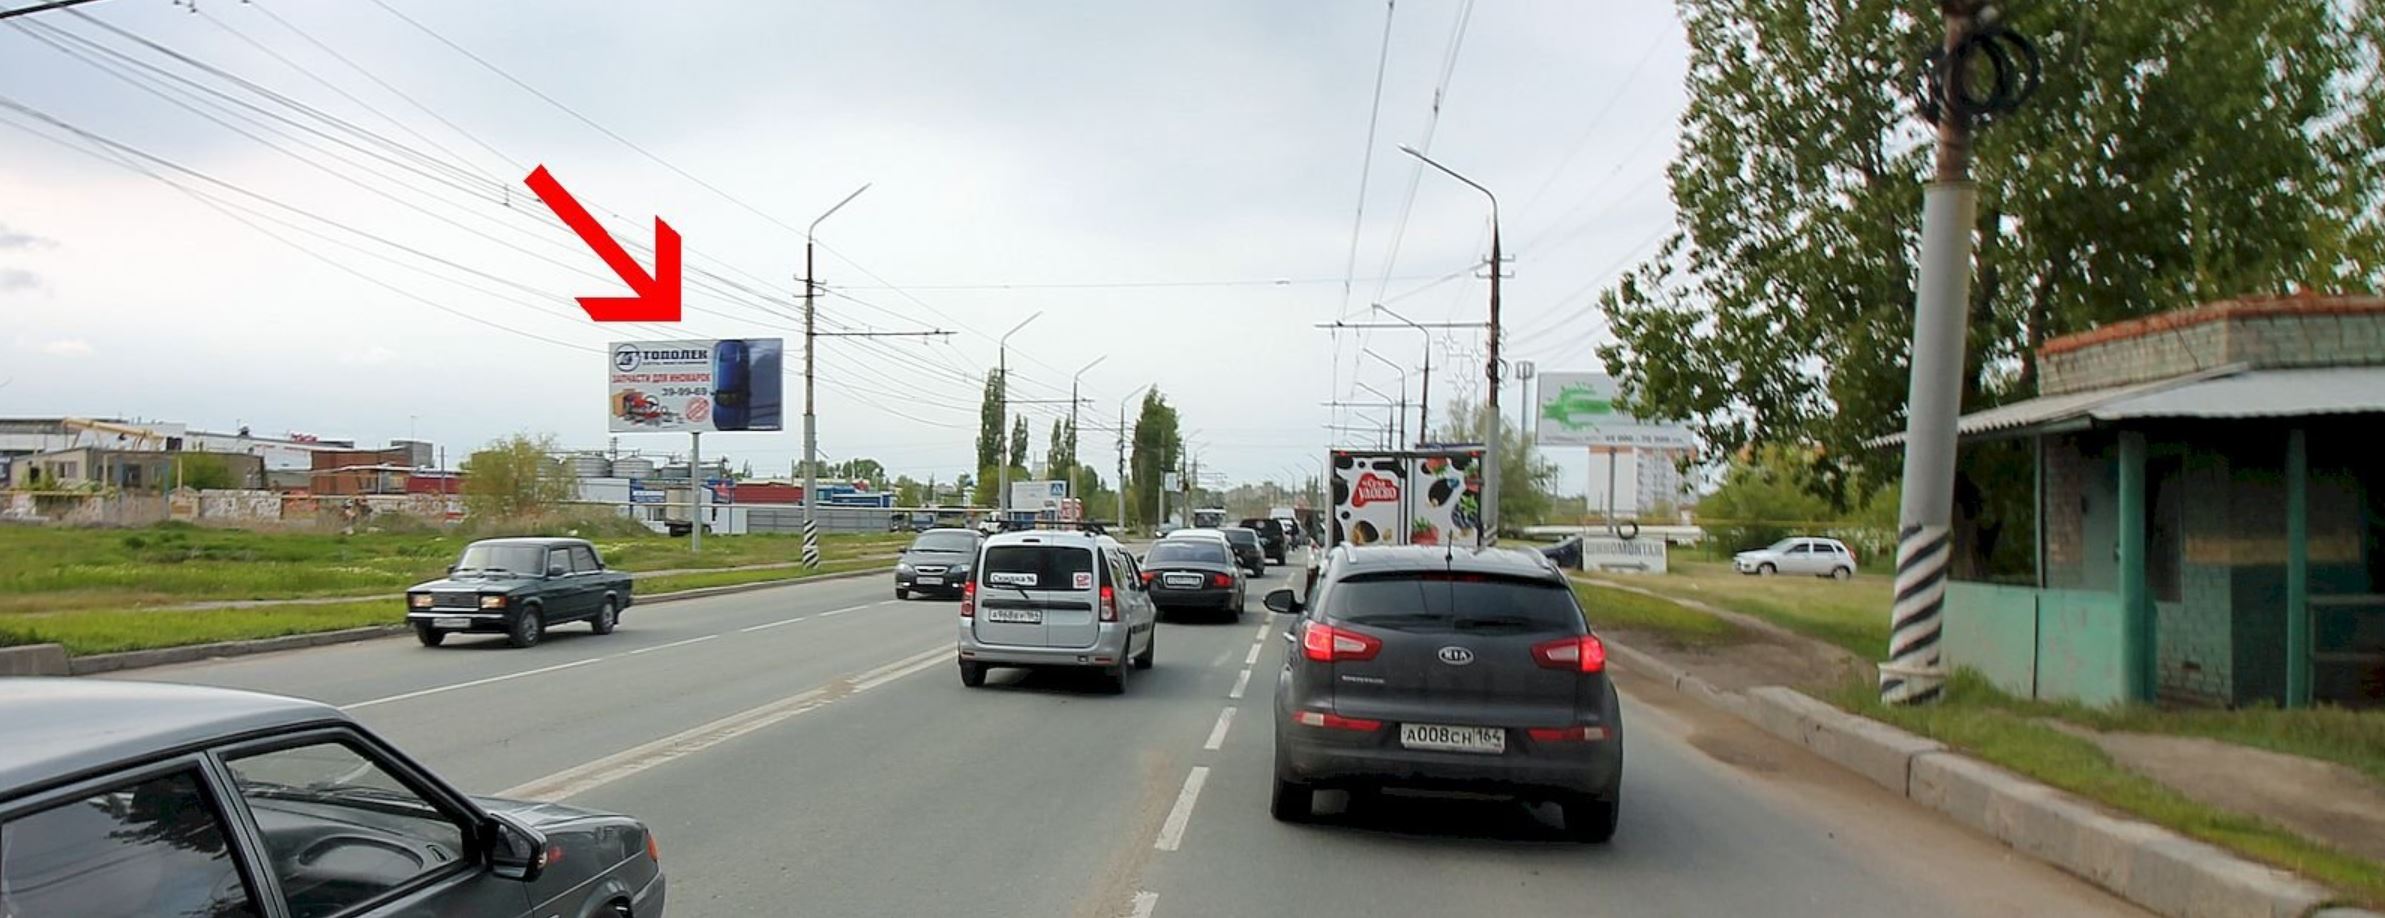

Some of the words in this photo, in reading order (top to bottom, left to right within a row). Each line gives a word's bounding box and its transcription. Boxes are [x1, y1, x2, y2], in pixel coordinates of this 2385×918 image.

[642, 350, 708, 360] ТОПОЛЕК
[612, 373, 650, 383] ЗАПЧАСТИ
[1405, 725, 1473, 746] А008СН
[1477, 728, 1502, 742] 164
